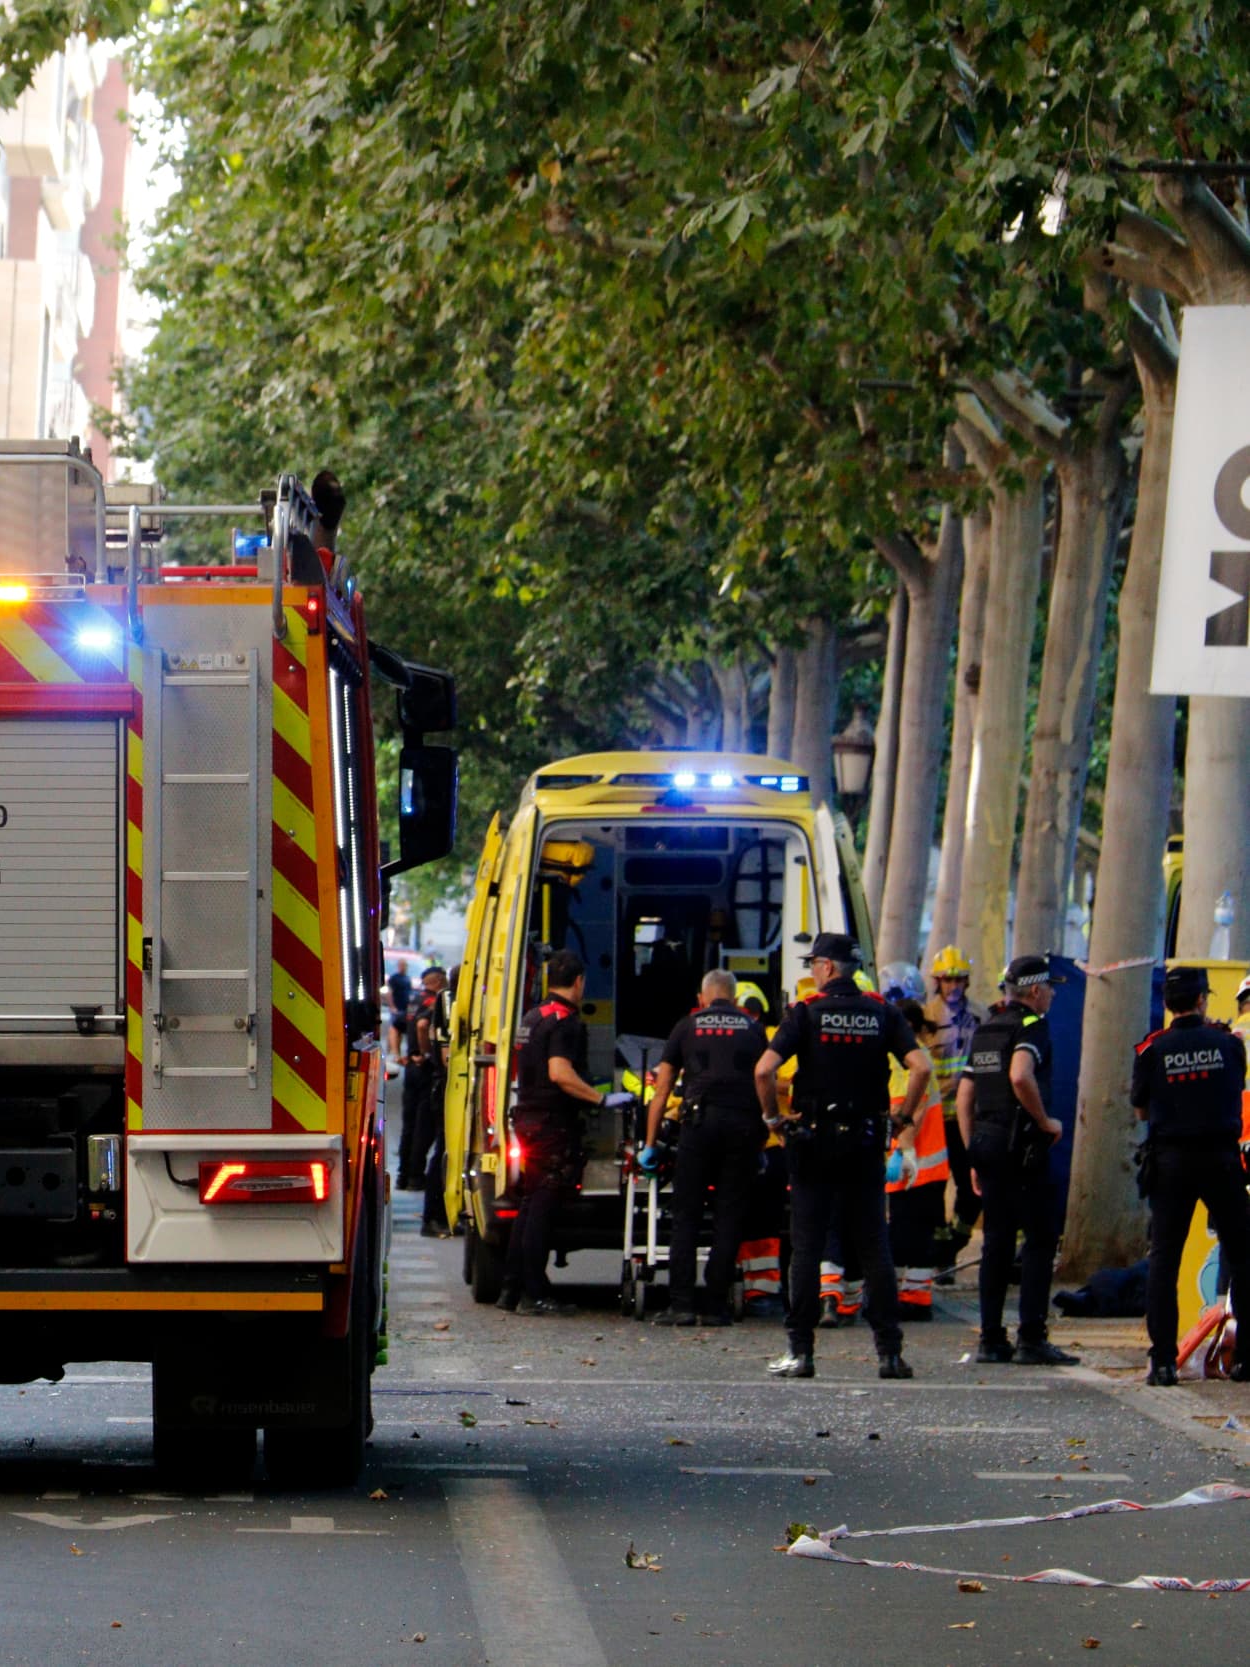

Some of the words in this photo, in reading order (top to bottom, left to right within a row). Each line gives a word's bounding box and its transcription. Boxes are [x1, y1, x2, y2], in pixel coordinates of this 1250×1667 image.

[696, 1015, 748, 1025] POLICIA
[821, 1014, 879, 1028] POLICIA
[1164, 1048, 1223, 1070] POLICIA
